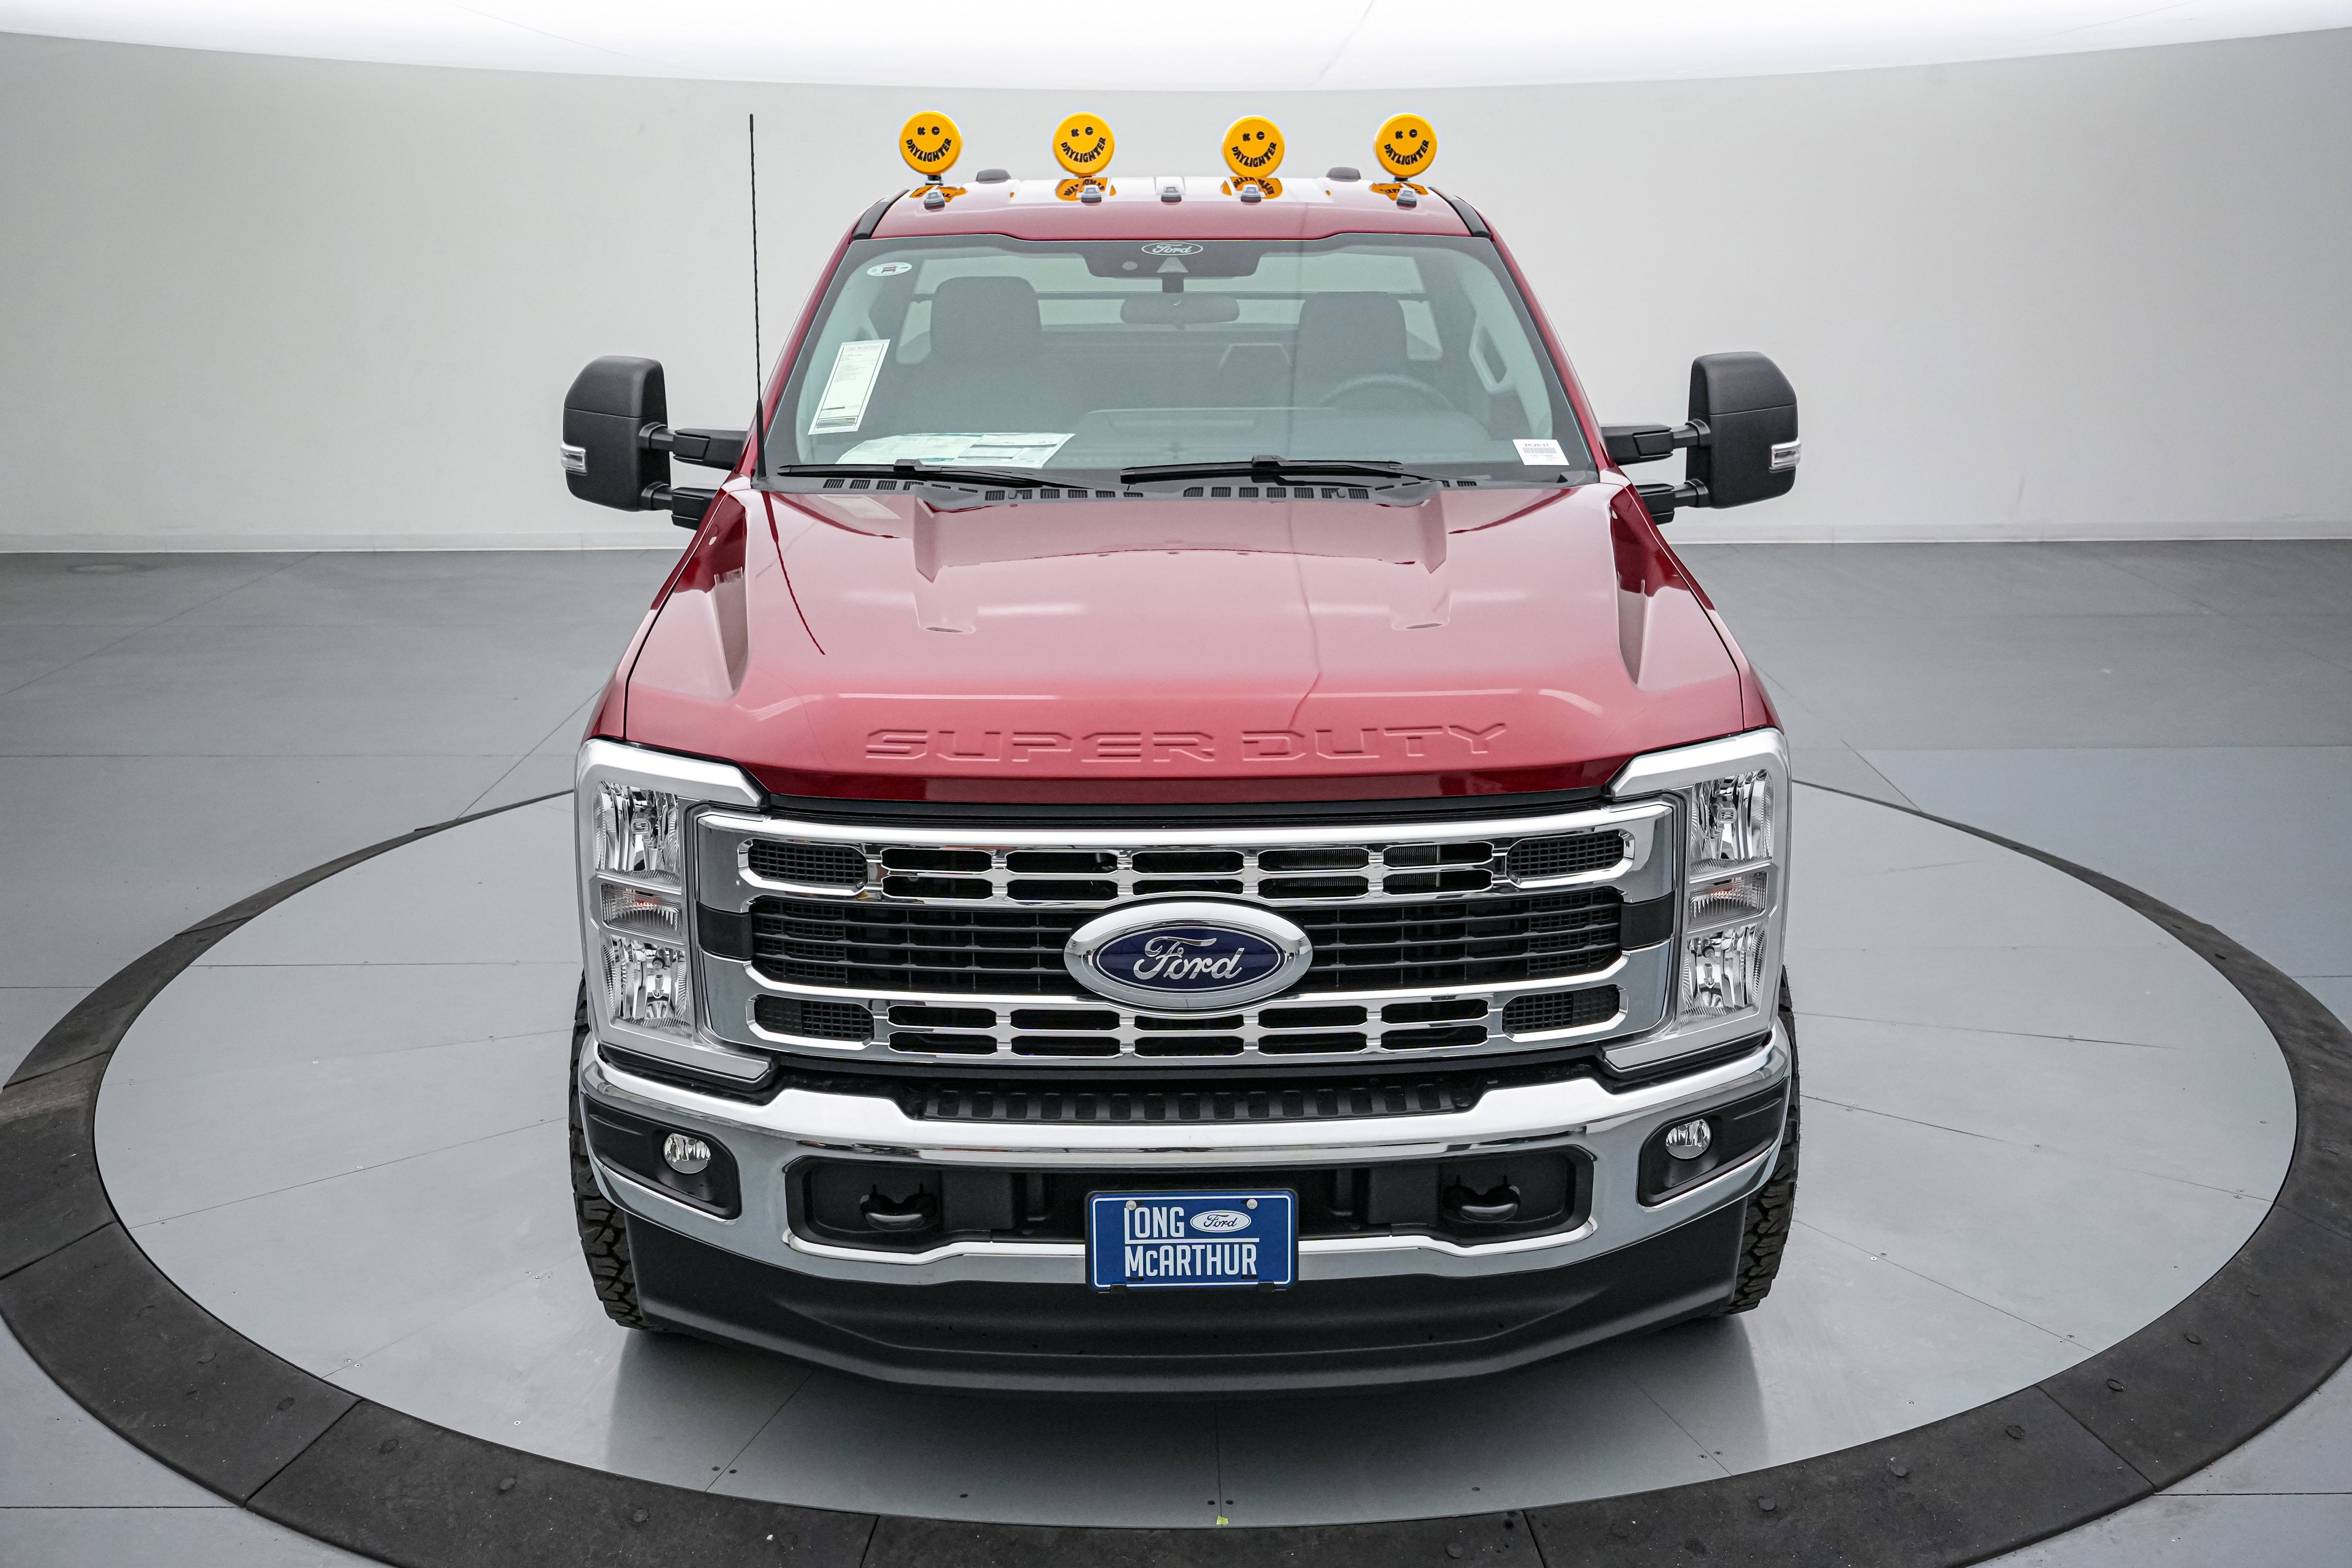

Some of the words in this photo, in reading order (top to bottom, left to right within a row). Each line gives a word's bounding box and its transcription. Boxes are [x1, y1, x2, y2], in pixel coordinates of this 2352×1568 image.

[906, 138, 951, 162] DAYLIGHTER
[1061, 137, 1106, 163] DAYLIGHTER
[1232, 142, 1277, 167] DAYLIGHTER
[1384, 140, 1429, 165] DAYLIGHTER
[1152, 243, 1192, 254] Ford
[866, 729, 1214, 762] SUPER
[1242, 723, 1506, 761] DUTY
[1134, 936, 1245, 980] Ford
[1124, 1207, 1185, 1244] LONG
[1204, 1214, 1237, 1227] Ford
